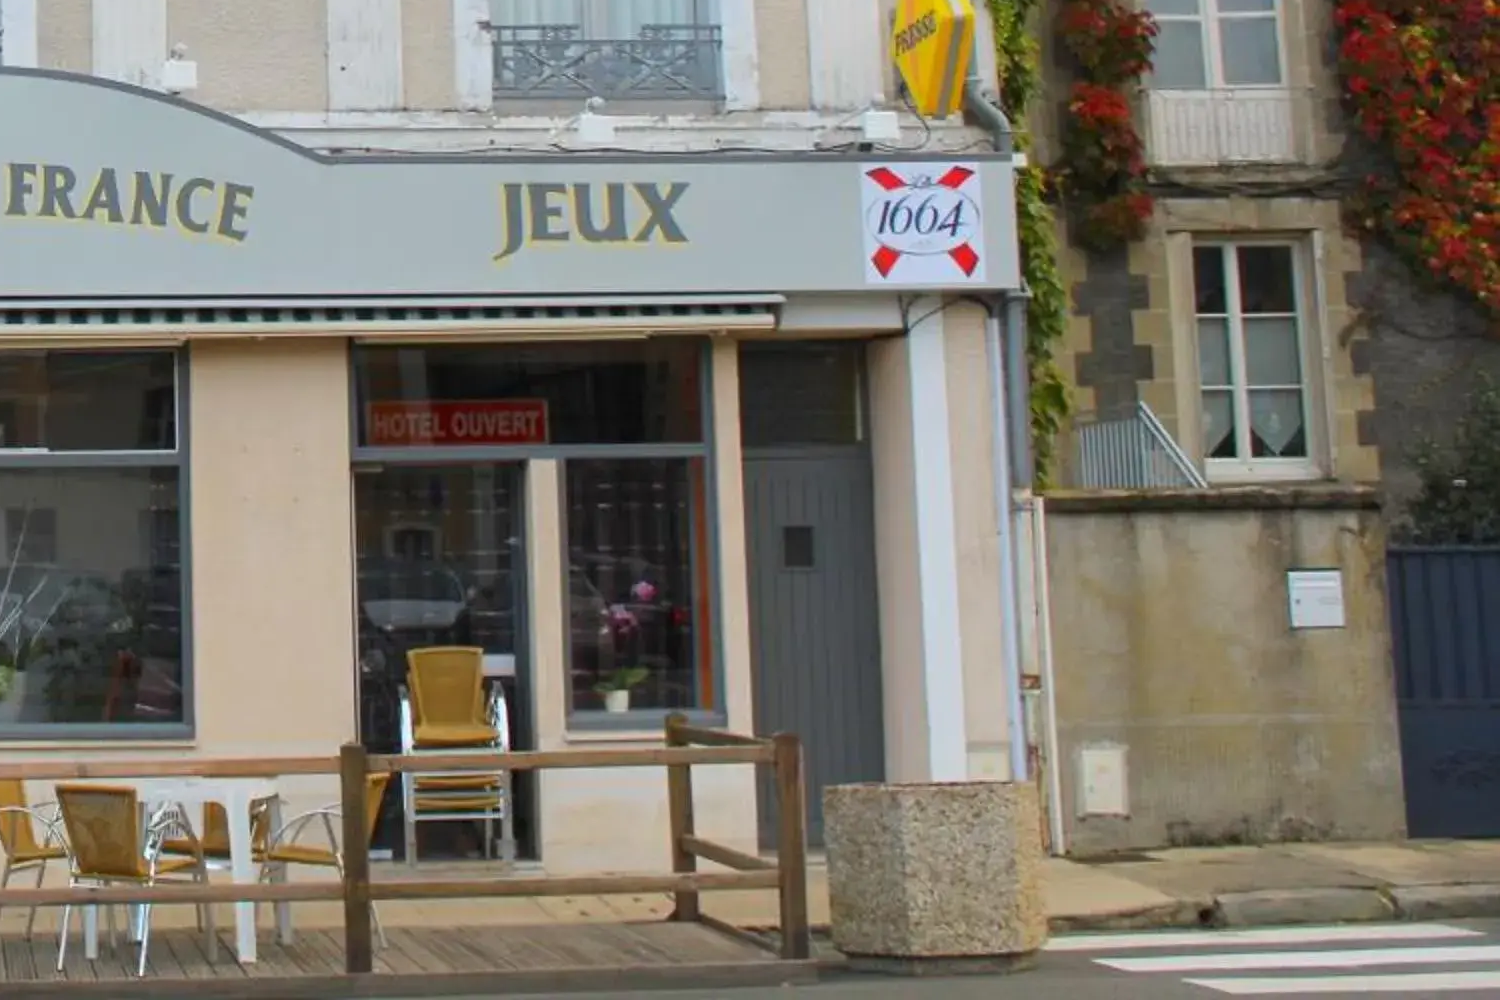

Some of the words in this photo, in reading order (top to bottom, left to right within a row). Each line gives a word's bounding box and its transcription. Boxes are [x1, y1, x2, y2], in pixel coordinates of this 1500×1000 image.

[893, 8, 938, 58] PRESSE
[3, 161, 255, 244] FRANCE
[490, 181, 691, 262] JEUX
[878, 192, 970, 238] 1664
[373, 411, 447, 439] HOTEL
[450, 409, 541, 438] OUVERT
